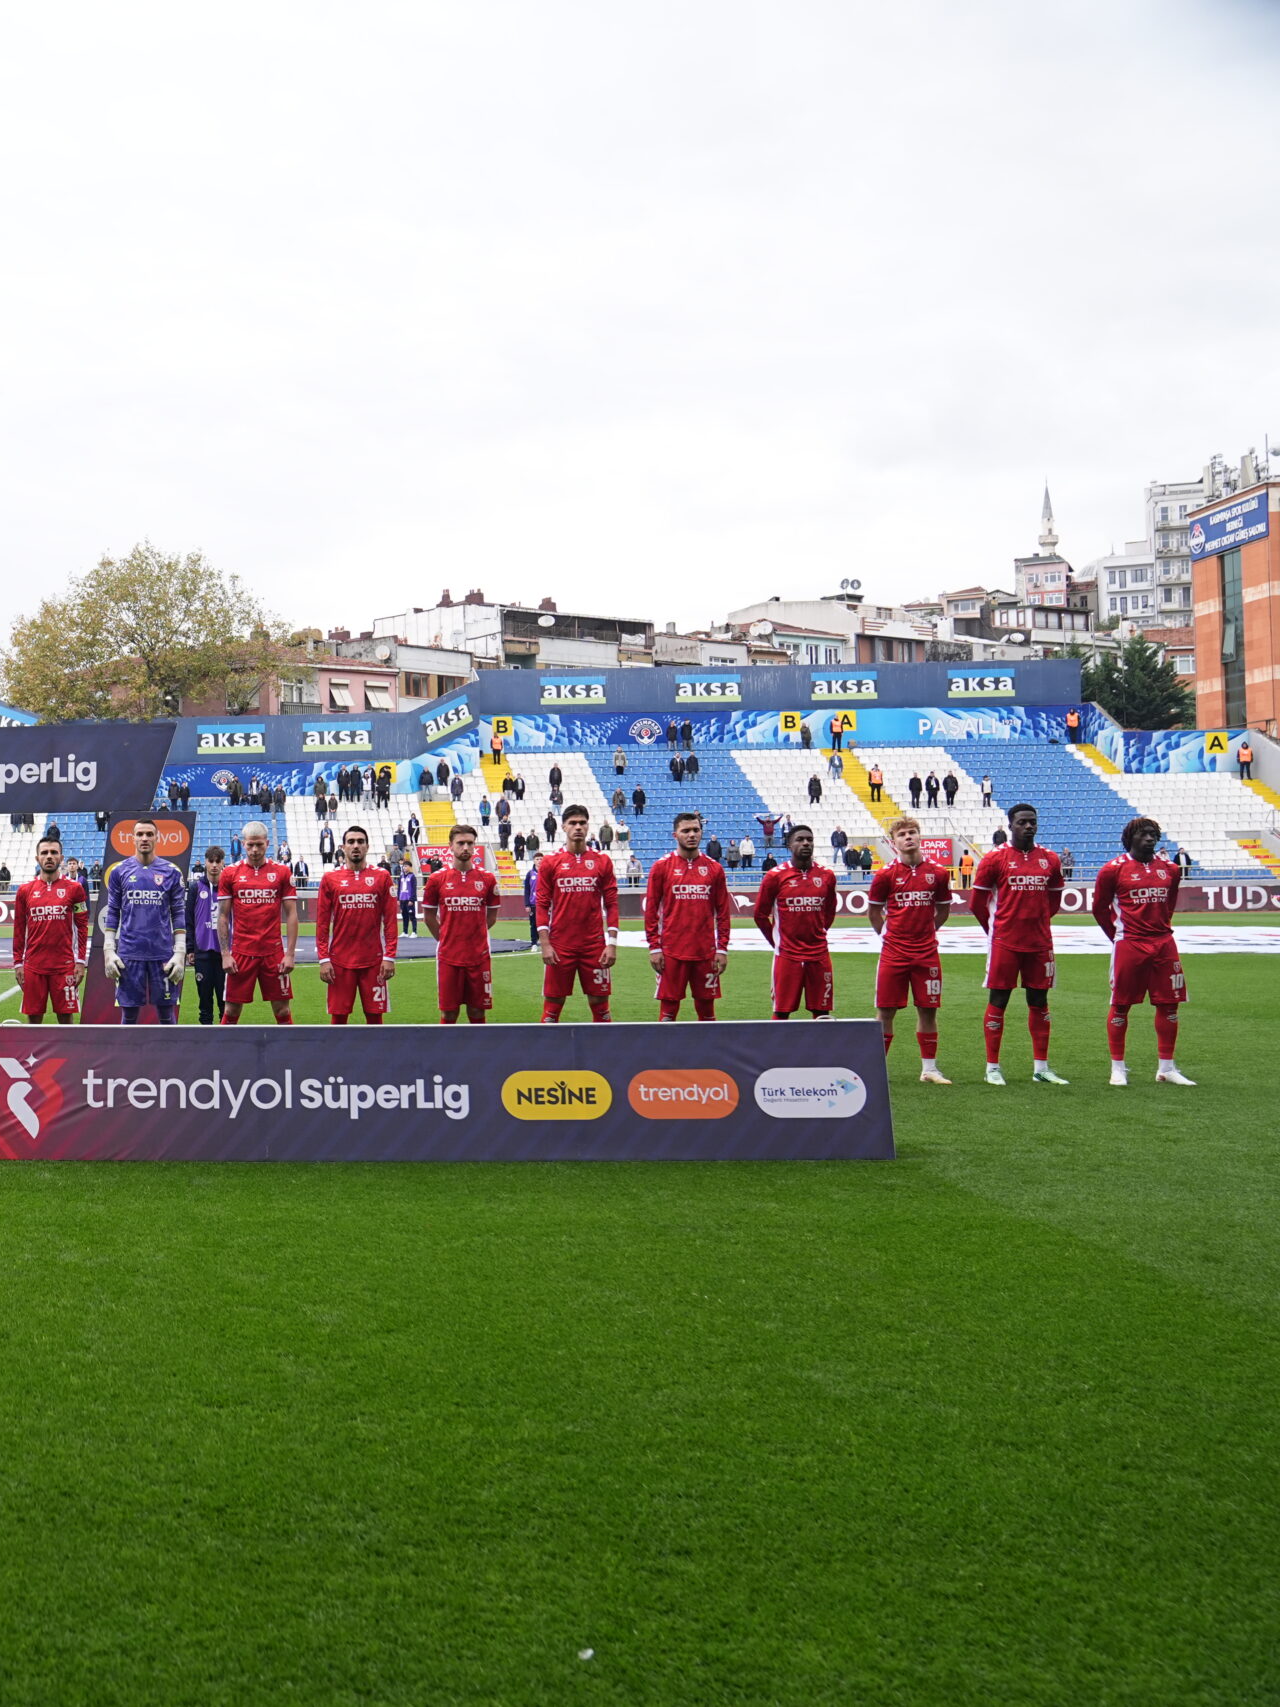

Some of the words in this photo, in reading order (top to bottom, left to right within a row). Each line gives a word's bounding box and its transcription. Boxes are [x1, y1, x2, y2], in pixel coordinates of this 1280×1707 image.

[543, 684, 604, 698] aksa
[678, 682, 740, 696] aksa
[814, 678, 875, 694] aksa
[950, 676, 1013, 692] aksa
[426, 704, 471, 736] aksa
[496, 720, 508, 734] B
[784, 715, 796, 728] B
[918, 718, 996, 736] PAŞALI
[200, 733, 264, 748] aksa
[305, 730, 370, 746] aksa
[1209, 736, 1224, 750] A
[557, 877, 598, 888] COREX
[1008, 876, 1050, 886] COREX
[126, 890, 165, 900] COREX
[238, 889, 277, 898] COREX
[672, 885, 712, 894] COREX
[894, 891, 935, 901] COREX
[1129, 888, 1170, 898] COREX
[338, 894, 377, 904] COREX
[444, 897, 483, 906] COREX
[786, 897, 826, 906] COREX
[1202, 886, 1280, 910] TUD
[30, 906, 68, 916] COREX
[593, 968, 610, 984] 34
[1170, 974, 1184, 990] 10
[924, 980, 941, 996] 19
[82, 1068, 292, 1118] trendyol
[300, 1074, 469, 1120] SüperLig
[638, 1083, 728, 1105] trendyol
[761, 1087, 786, 1096] Türk
[789, 1087, 838, 1096] Telekom
